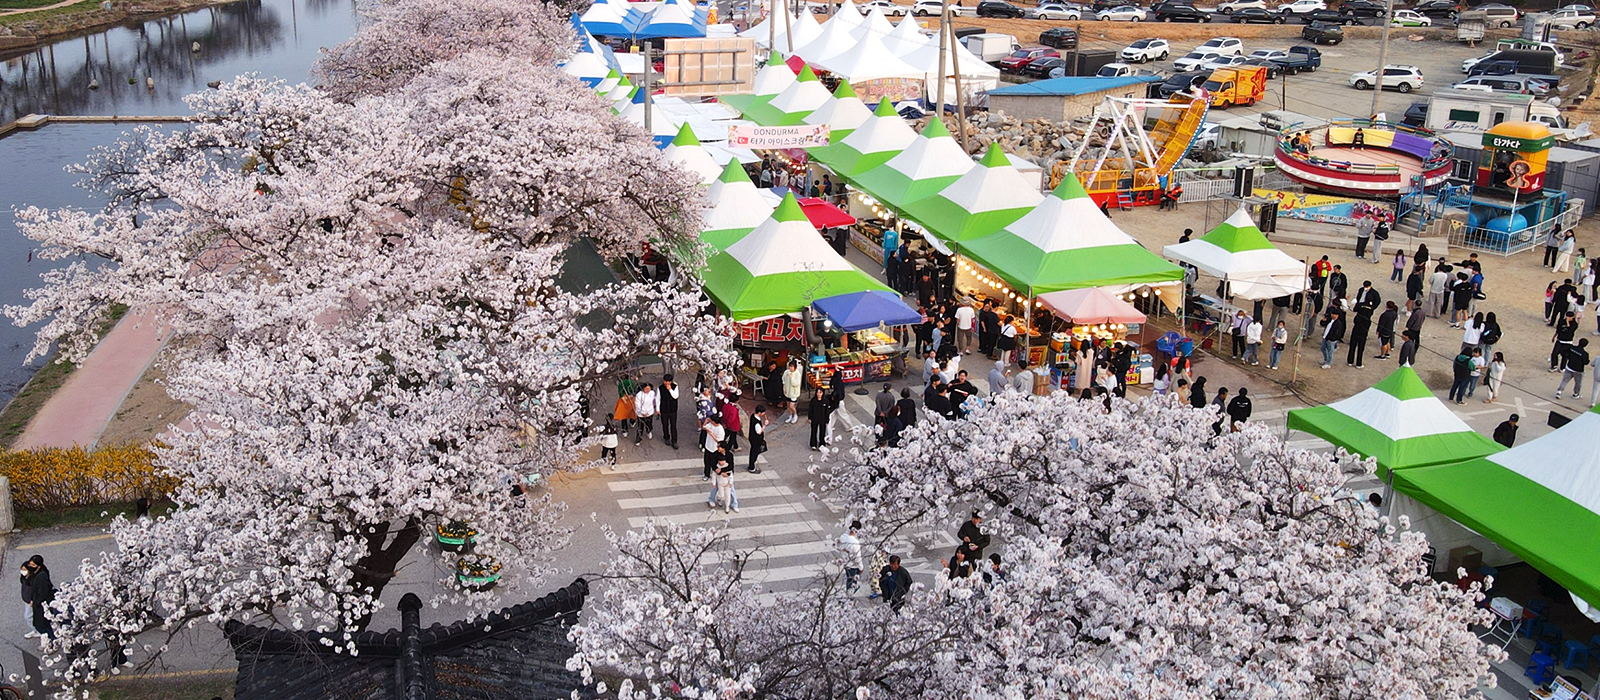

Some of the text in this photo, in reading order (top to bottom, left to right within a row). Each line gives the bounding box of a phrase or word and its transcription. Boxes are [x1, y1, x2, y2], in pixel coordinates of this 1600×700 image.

[753, 128, 799, 136] DONDURMA
[1493, 137, 1521, 149] 타가다
[841, 368, 863, 380] 꼬치
